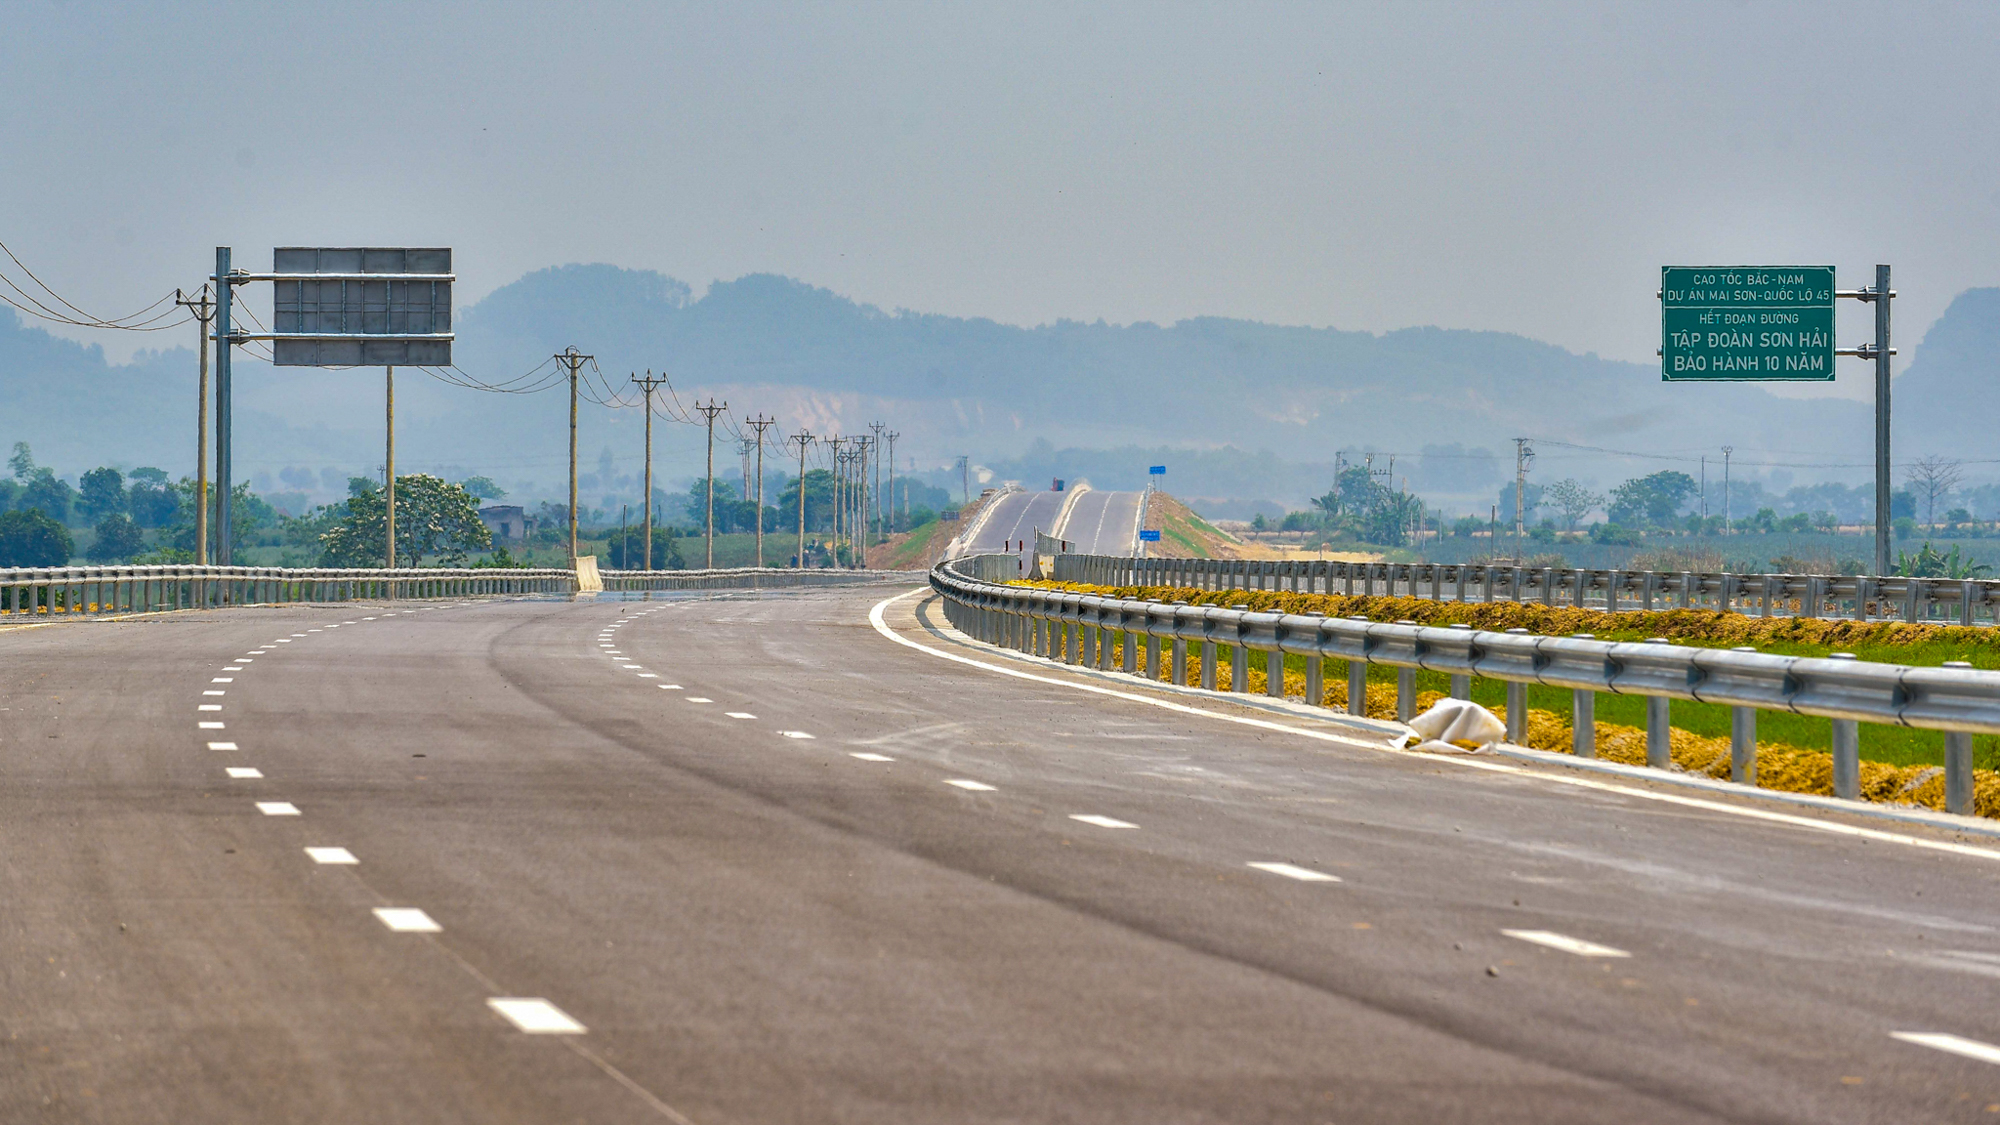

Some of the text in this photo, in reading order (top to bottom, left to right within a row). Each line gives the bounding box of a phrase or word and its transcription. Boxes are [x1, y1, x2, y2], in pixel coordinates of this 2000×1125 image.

[1694, 270, 1803, 284] CAO TỐC BẮC-NAM
[1668, 286, 1829, 303] DỰ ÁN MAI SƠN-QUỐC LỘ 45
[1700, 309, 1799, 326] HẾT ĐOẠN ĐƯỜNG
[1671, 327, 1827, 350] TẬP ĐOÀN SƠN HẢI
[1674, 351, 1823, 371] BẢO HÀNH 10 NĂM
